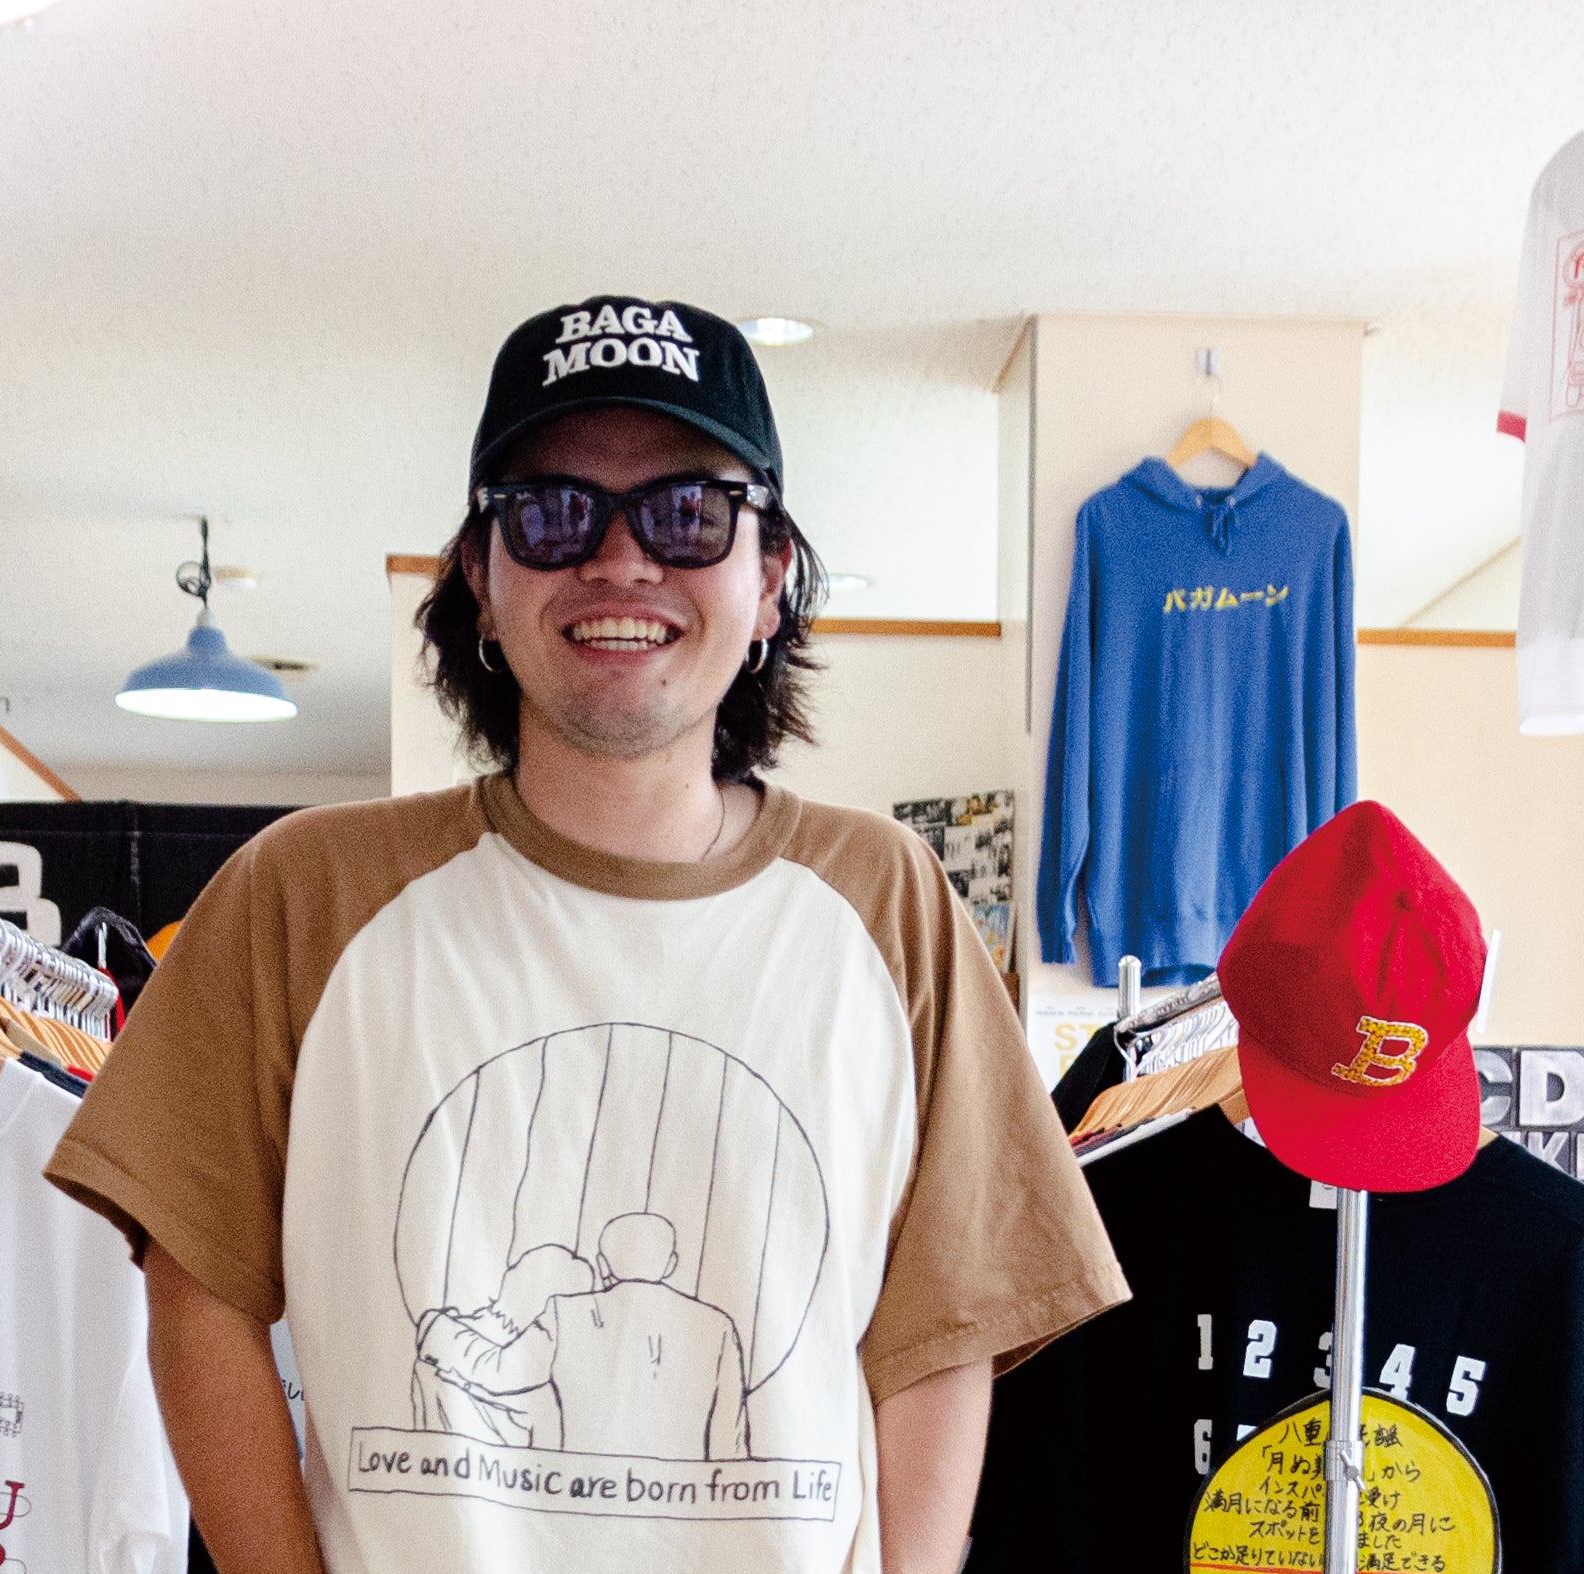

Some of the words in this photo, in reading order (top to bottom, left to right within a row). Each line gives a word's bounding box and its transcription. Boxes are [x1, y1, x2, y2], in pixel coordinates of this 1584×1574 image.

[556, 304, 693, 344] BAGA
[542, 337, 701, 387] MOON
[1162, 583, 1289, 613] バガムーン
[1331, 1015, 1430, 1087] B
[1197, 1313, 1214, 1370] 1
[1243, 1319, 1278, 1379] 2
[1379, 1343, 1416, 1401] 4
[1446, 1355, 1487, 1417] 5
[357, 1440, 412, 1477] Love
[420, 1449, 471, 1480] and
[478, 1453, 563, 1496] Music
[570, 1477, 617, 1501] are
[626, 1469, 698, 1504] born
[705, 1470, 780, 1502] from
[792, 1470, 833, 1502] Life
[1194, 1418, 1213, 1475] 6
